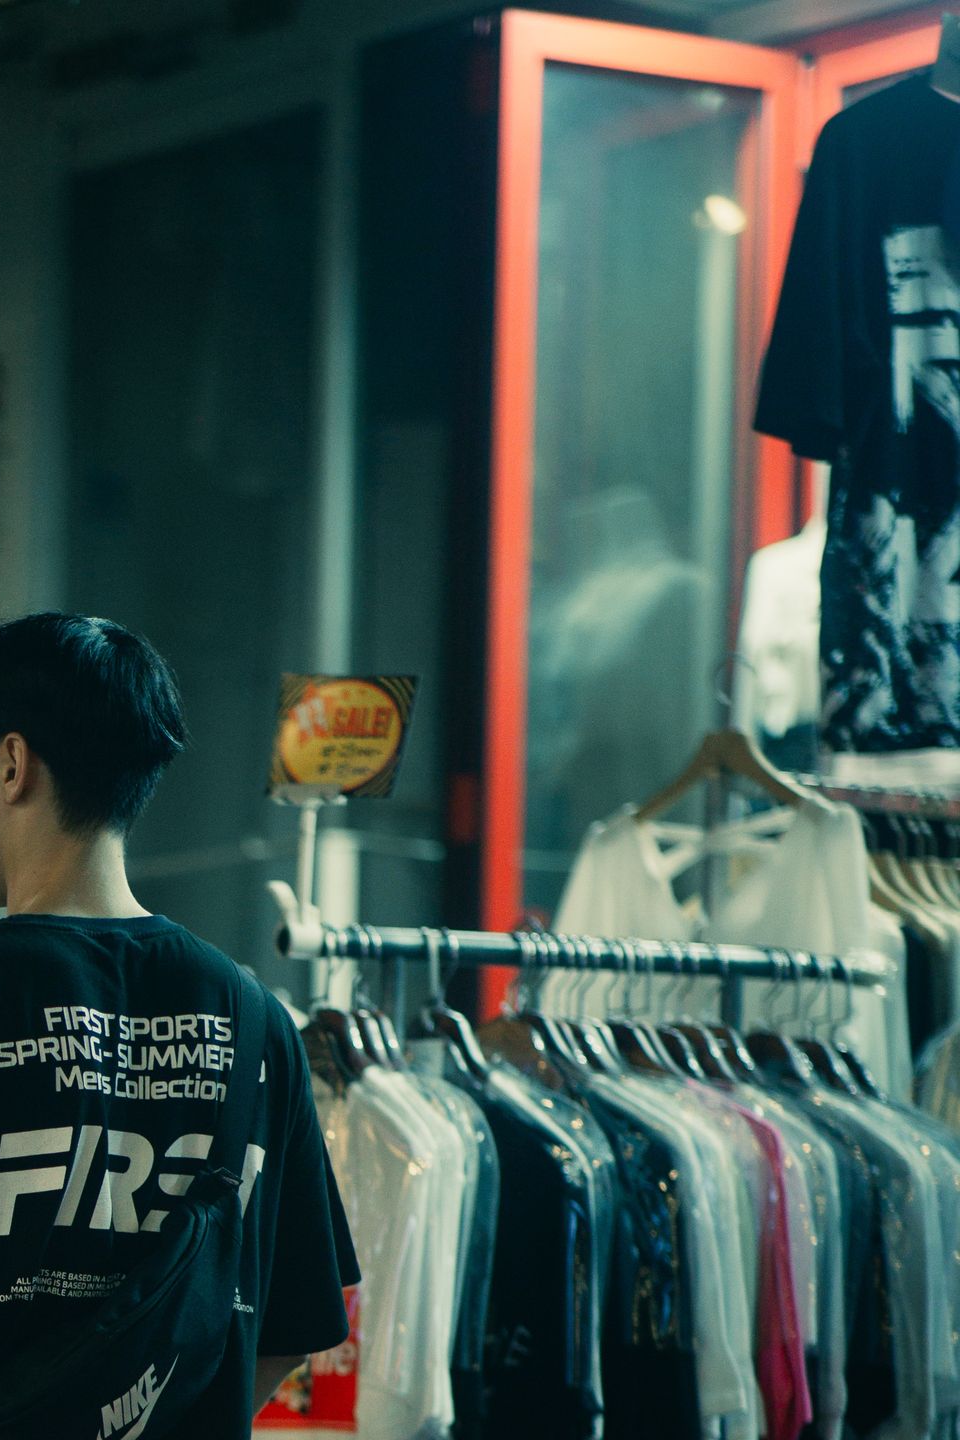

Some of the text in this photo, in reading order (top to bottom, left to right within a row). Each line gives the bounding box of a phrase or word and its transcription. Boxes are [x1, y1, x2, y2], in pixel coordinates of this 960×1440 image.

[44, 1005, 232, 1042] FIRST SPORTS
[117, 1044, 235, 1071] SUMMER
[115, 1072, 227, 1103] Collection
[16, 1276, 31, 1285] ALL
[62, 1280, 87, 1290] BASED
[50, 1270, 67, 1280] ARE
[68, 1272, 92, 1282] BASED
[100, 1362, 161, 1439] NIKE
